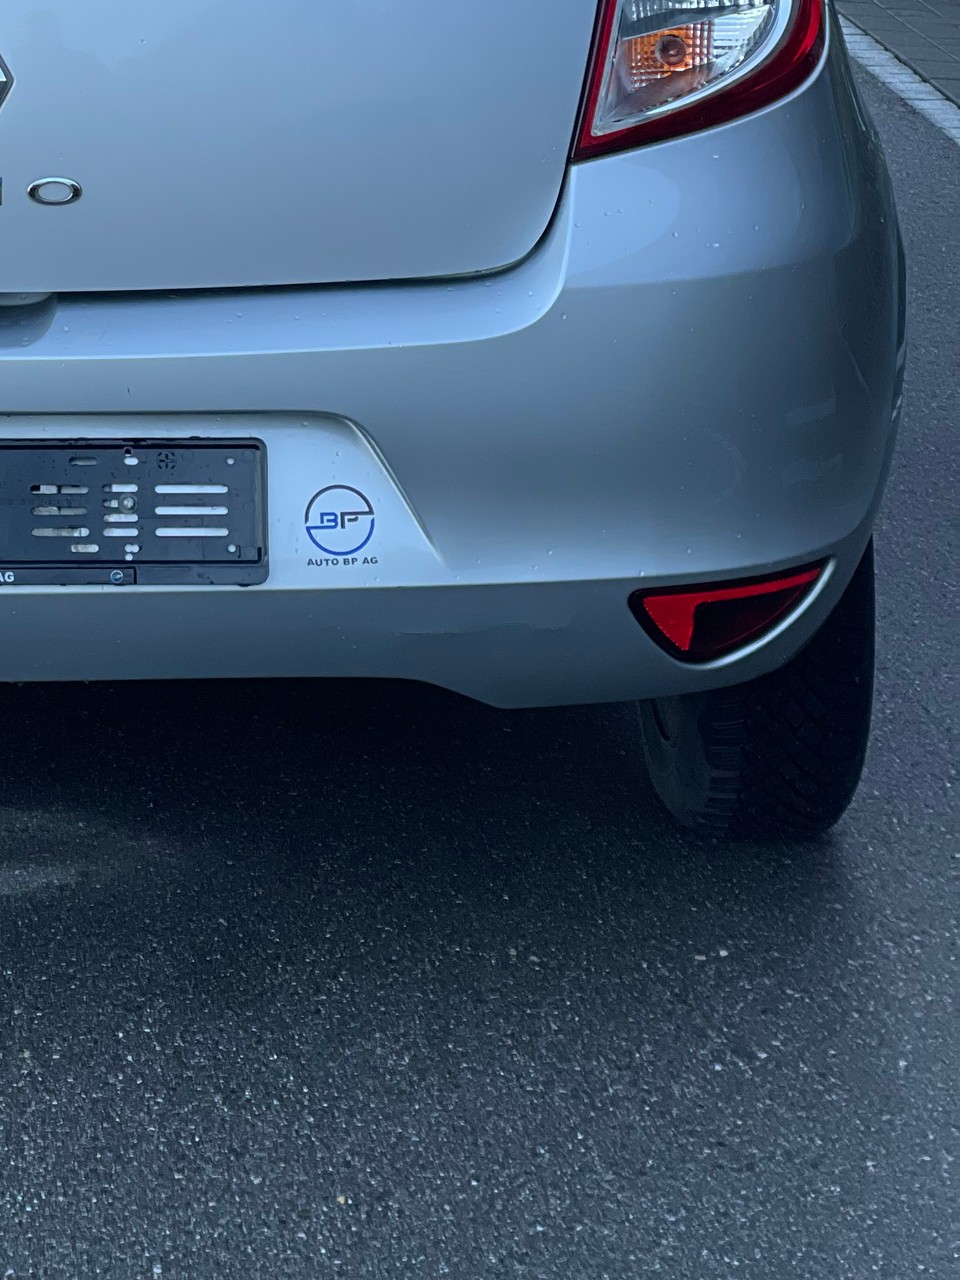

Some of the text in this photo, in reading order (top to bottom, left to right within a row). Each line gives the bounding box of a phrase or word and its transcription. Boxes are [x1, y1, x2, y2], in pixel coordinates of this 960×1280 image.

[307, 556, 379, 567] AUTO BP AG
